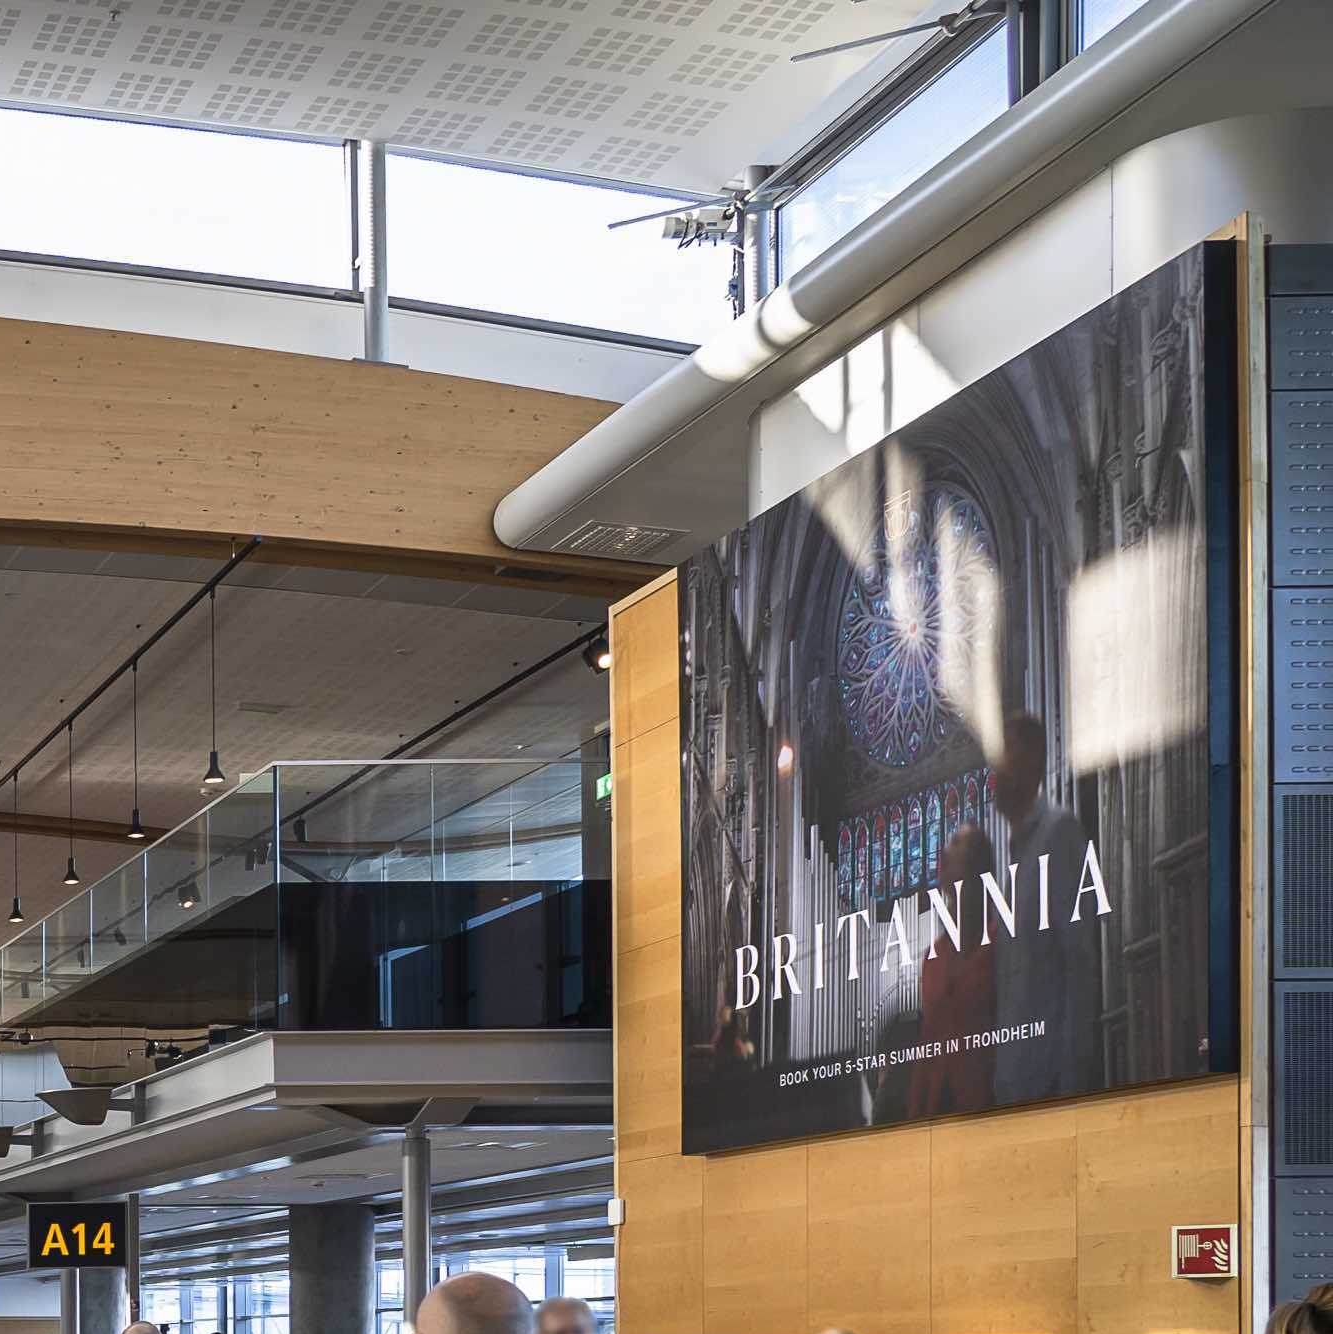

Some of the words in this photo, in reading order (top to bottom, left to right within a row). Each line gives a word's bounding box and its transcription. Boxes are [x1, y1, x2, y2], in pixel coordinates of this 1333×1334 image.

[734, 839, 1113, 1011] BRITANNIA
[779, 1071, 809, 1087] BOOK
[812, 1062, 842, 1081] YOUR
[845, 1053, 886, 1074] 5-STAR
[890, 1042, 942, 1064] SUMMER
[946, 1039, 959, 1055] IN
[963, 1020, 1045, 1051] TRONDHEIM
[40, 1222, 115, 1256] A14
